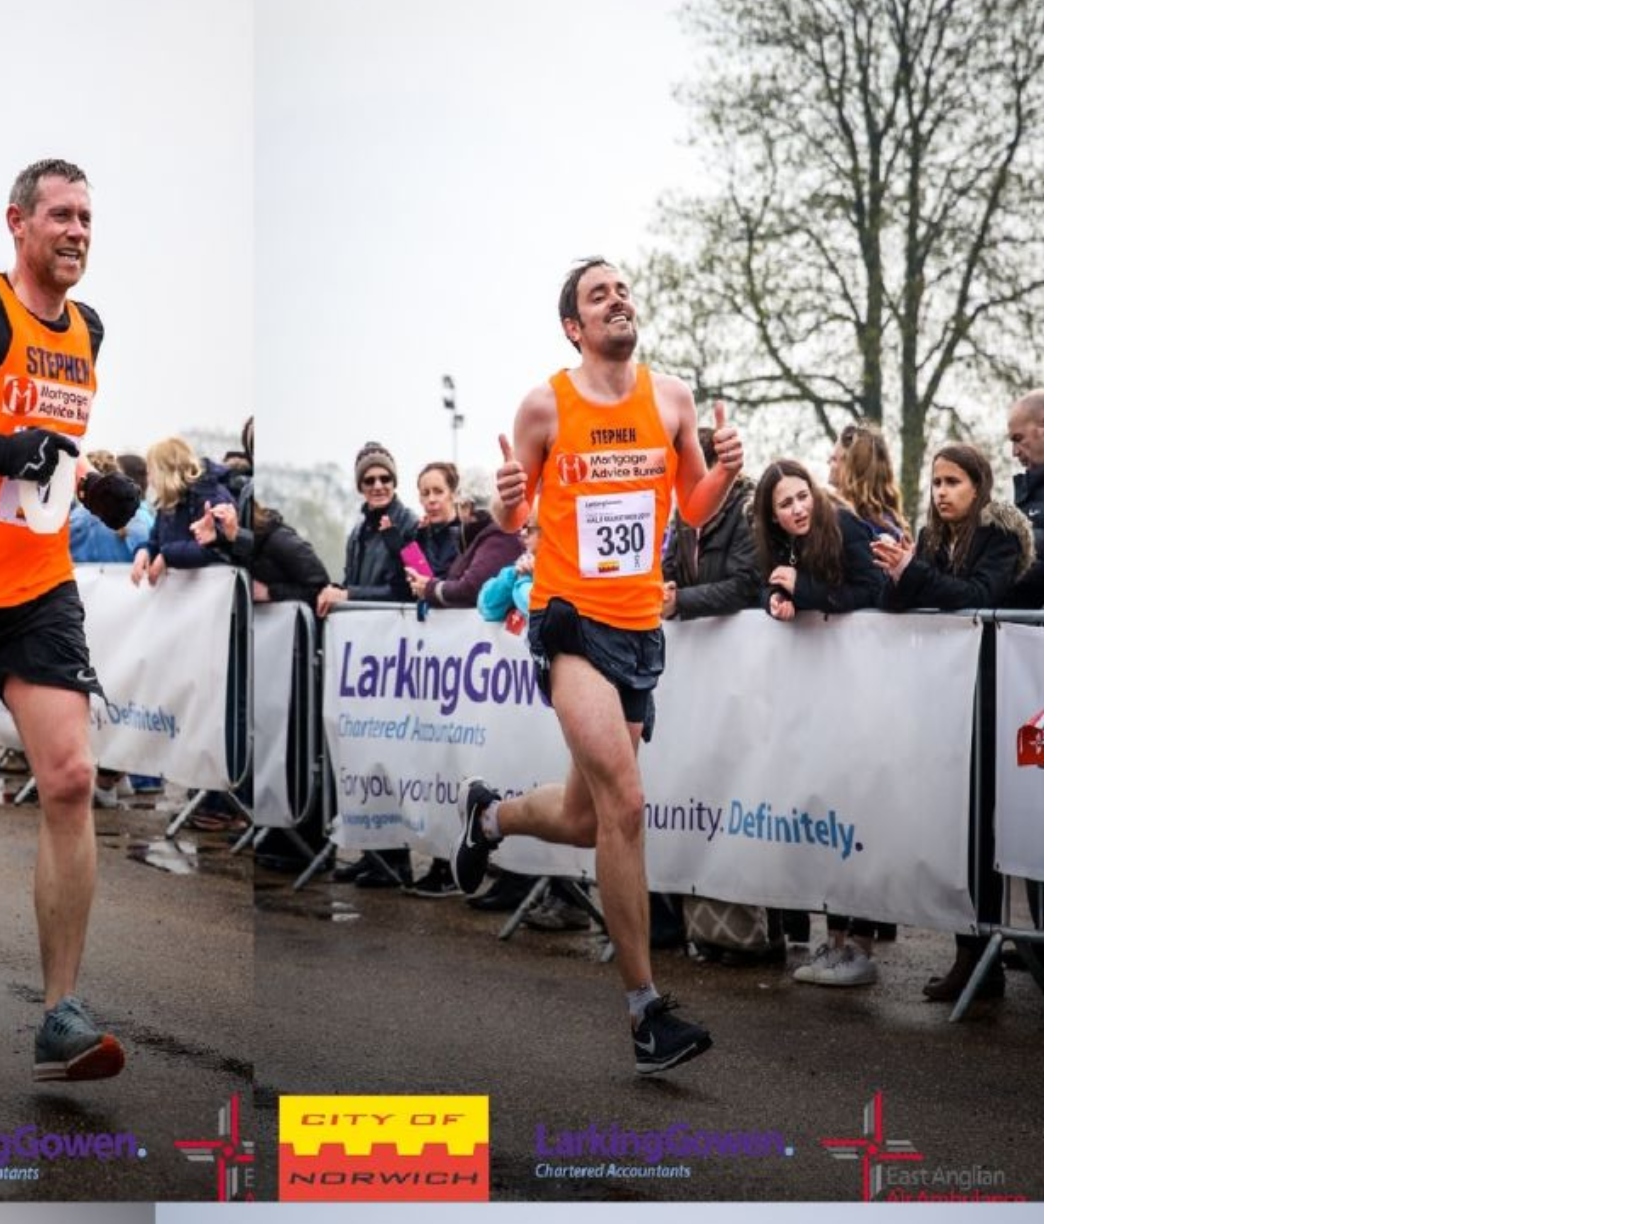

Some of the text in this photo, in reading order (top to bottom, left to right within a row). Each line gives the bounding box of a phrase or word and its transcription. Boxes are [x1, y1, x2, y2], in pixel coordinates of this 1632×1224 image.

[26, 346, 90, 383] STEPHEN
[38, 402, 75, 420] Advice
[590, 427, 637, 445] STEPHEN
[590, 453, 648, 467] Mortgage
[591, 467, 631, 479] Advice
[596, 522, 645, 556] 330
[338, 713, 411, 740] Chartered
[727, 798, 864, 860] Definitely.
